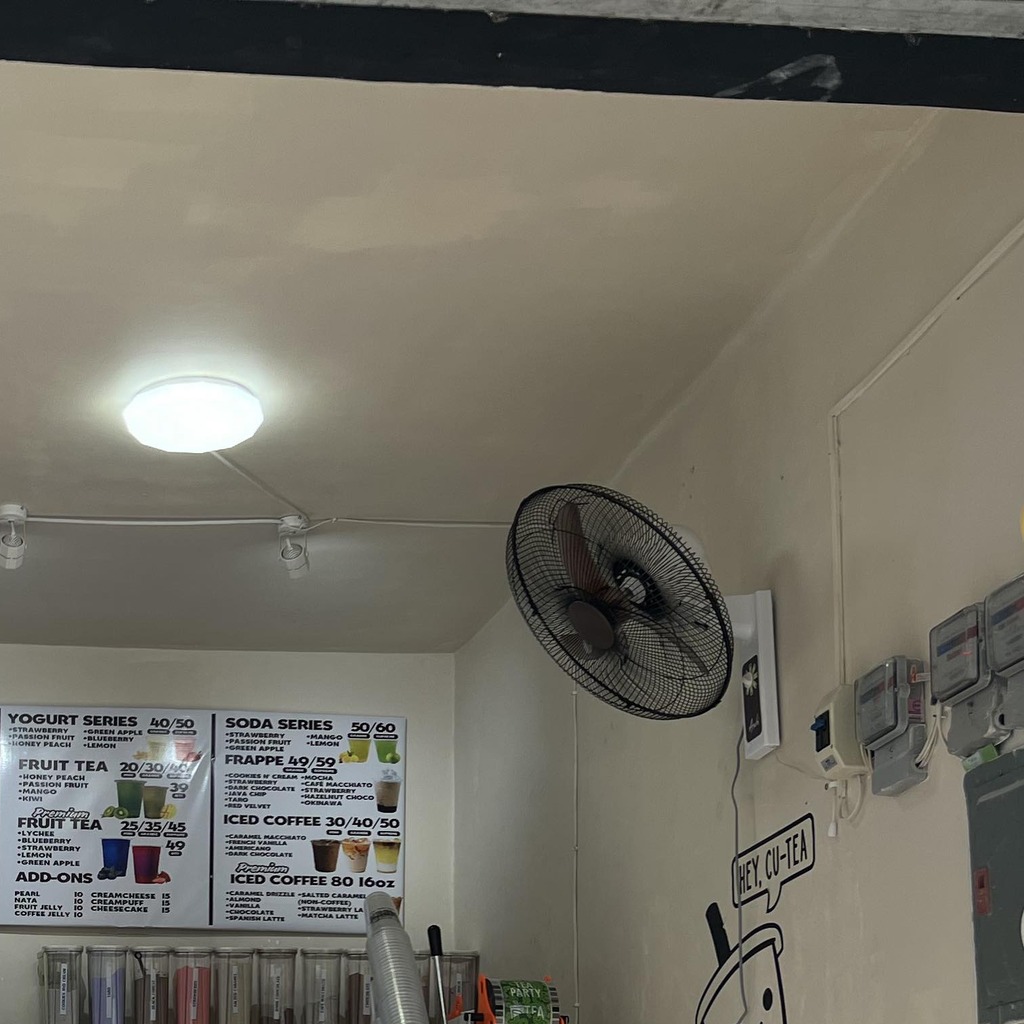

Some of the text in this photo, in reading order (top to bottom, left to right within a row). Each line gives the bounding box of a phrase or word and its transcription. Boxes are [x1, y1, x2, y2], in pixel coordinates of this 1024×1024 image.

[8, 714, 137, 726] YOGURT SERIES
[149, 718, 194, 728] 40/50
[226, 718, 333, 730] SODA SERIES
[351, 722, 395, 733] 50/60
[19, 759, 108, 772] FRUIT TEA
[225, 755, 336, 768] FRAPPE 49/59
[170, 783, 188, 793] 39
[31, 806, 90, 819] Premium
[18, 818, 102, 830] FRUIT TEA
[121, 821, 186, 832] 25/35/45
[224, 815, 400, 828] ICED COFFEE 30/40/50
[166, 840, 185, 851] 49
[235, 862, 289, 873] Premium
[738, 829, 808, 895] HEY, CU-TEA
[16, 872, 93, 883] ADD-ONS
[230, 874, 395, 888] ICED COFFEE 80 16oz
[510, 987, 541, 998] PARTY
